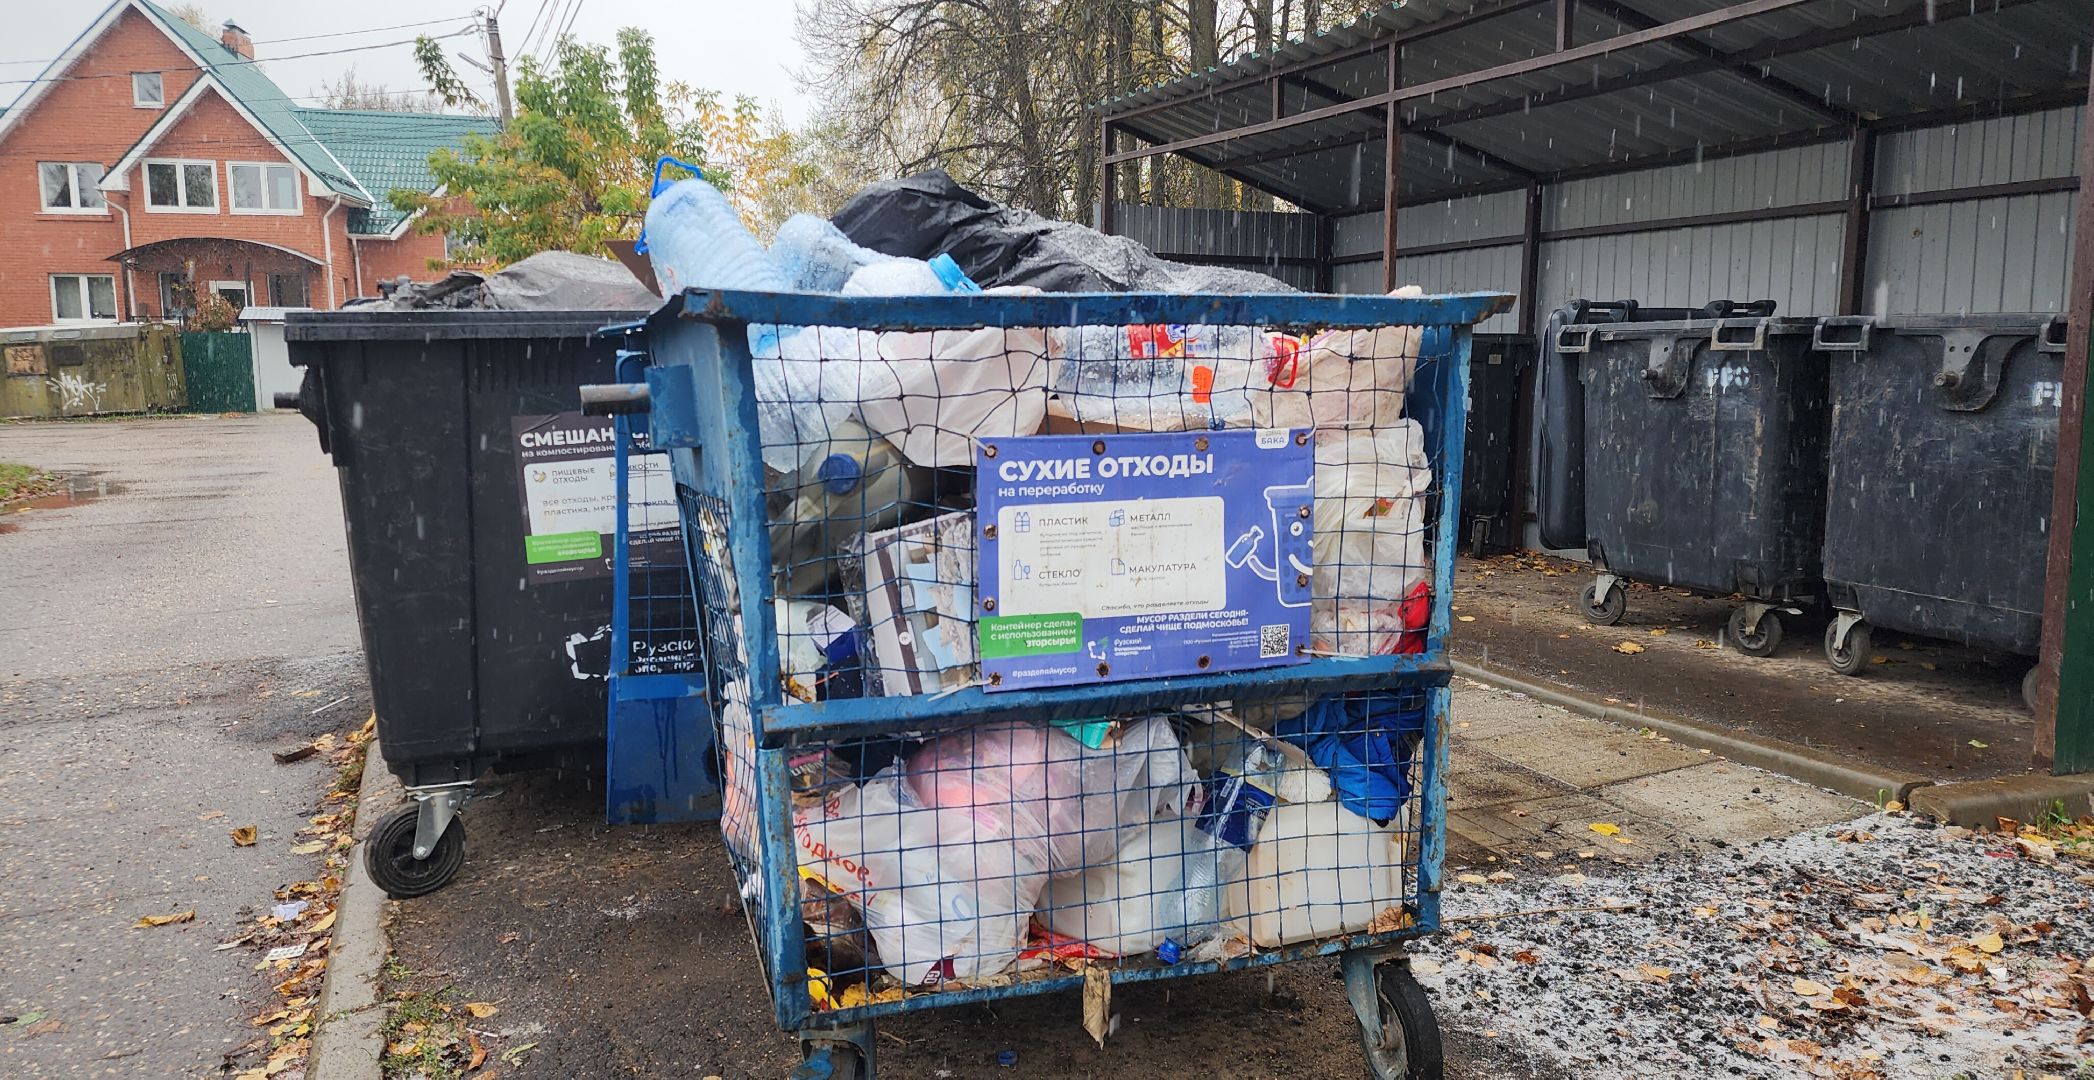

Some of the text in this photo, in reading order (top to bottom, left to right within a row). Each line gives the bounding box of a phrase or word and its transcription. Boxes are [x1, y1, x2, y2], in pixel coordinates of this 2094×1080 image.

[520, 427, 649, 447] СМЕШАН
[1261, 437, 1284, 445] БАКА
[521, 444, 616, 458] на компостирован
[552, 467, 596, 477] ПИЩЕВЫЕ
[999, 454, 1213, 482] СУХИЕ ОТХОДЫ
[552, 476, 588, 484] ОТХОДЫ
[998, 482, 1105, 498] на переработку
[543, 499, 560, 507] все
[1039, 516, 1089, 527] ПЛАСТИК
[1130, 512, 1171, 523] МЕТАЛЛ
[1129, 562, 1197, 574] МАКУЛАТУРА
[1038, 569, 1081, 580] СТЕКЛО
[1136, 614, 1167, 624] МУСОР
[1168, 611, 1208, 622] РАЗДЕЛИ
[991, 619, 1076, 633] Контейнер сделан
[1119, 622, 1155, 634] СДЕЛАЙ
[1156, 621, 1182, 632] ЧИЩЕ
[998, 628, 1076, 641] использованием
